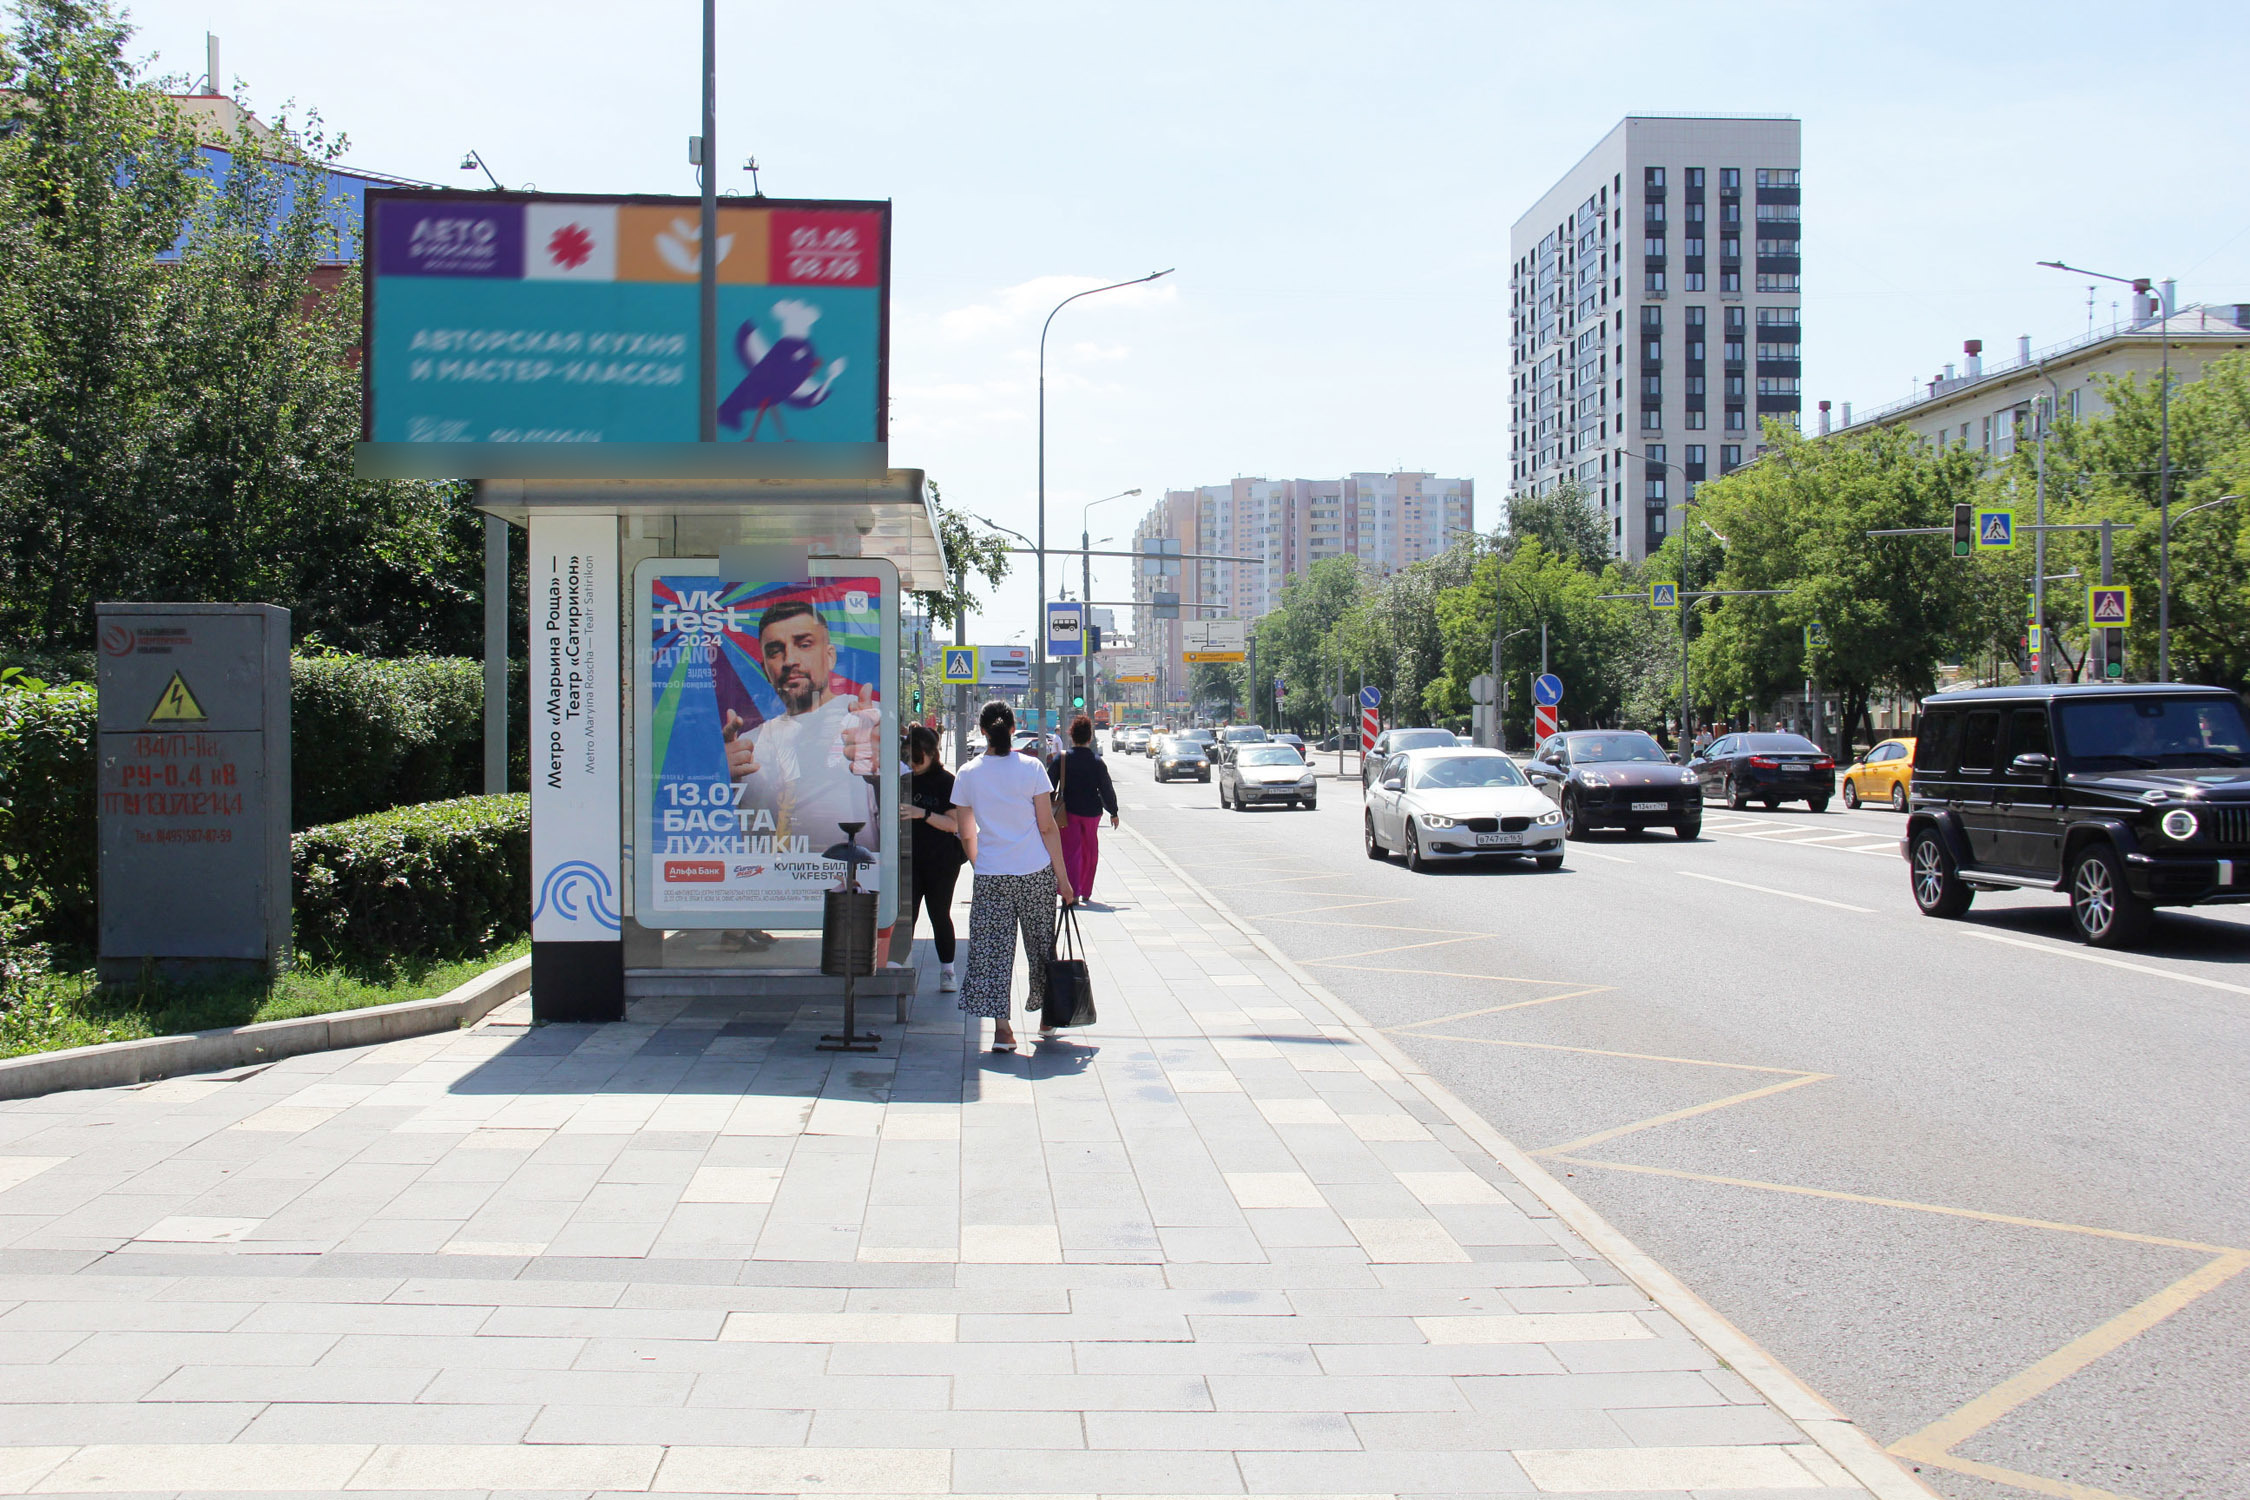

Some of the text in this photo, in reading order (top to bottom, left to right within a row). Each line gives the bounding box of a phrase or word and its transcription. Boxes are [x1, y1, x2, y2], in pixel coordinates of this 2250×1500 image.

[407, 217, 499, 245] ЛЕТО
[408, 328, 688, 357] АВТОРСКАЯ КУХНЯ
[409, 357, 686, 386] И МАСТЕР-КЛАССЫ
[584, 555, 594, 604] Satirikon
[546, 577, 563, 631] Роща»
[675, 590, 725, 611] VK
[848, 597, 865, 608] VK
[584, 606, 594, 636] Teatr
[652, 604, 750, 633] fest
[565, 555, 582, 720] Театр «Сатирикон»
[677, 634, 723, 647] 2024
[546, 636, 564, 725] «Марьина
[584, 650, 594, 689] Roscha
[584, 691, 595, 737] Maryina
[547, 731, 564, 789] Метро
[584, 740, 595, 774] Metro
[663, 782, 748, 806] 13.07
[663, 808, 777, 832] БАСТА
[664, 835, 809, 855] ЛУЖНИКИ
[669, 866, 720, 877] Альфа Банк
[774, 862, 870, 871] КУПИТЬ БИЛЫ
[792, 871, 847, 880] VKFEST.R
